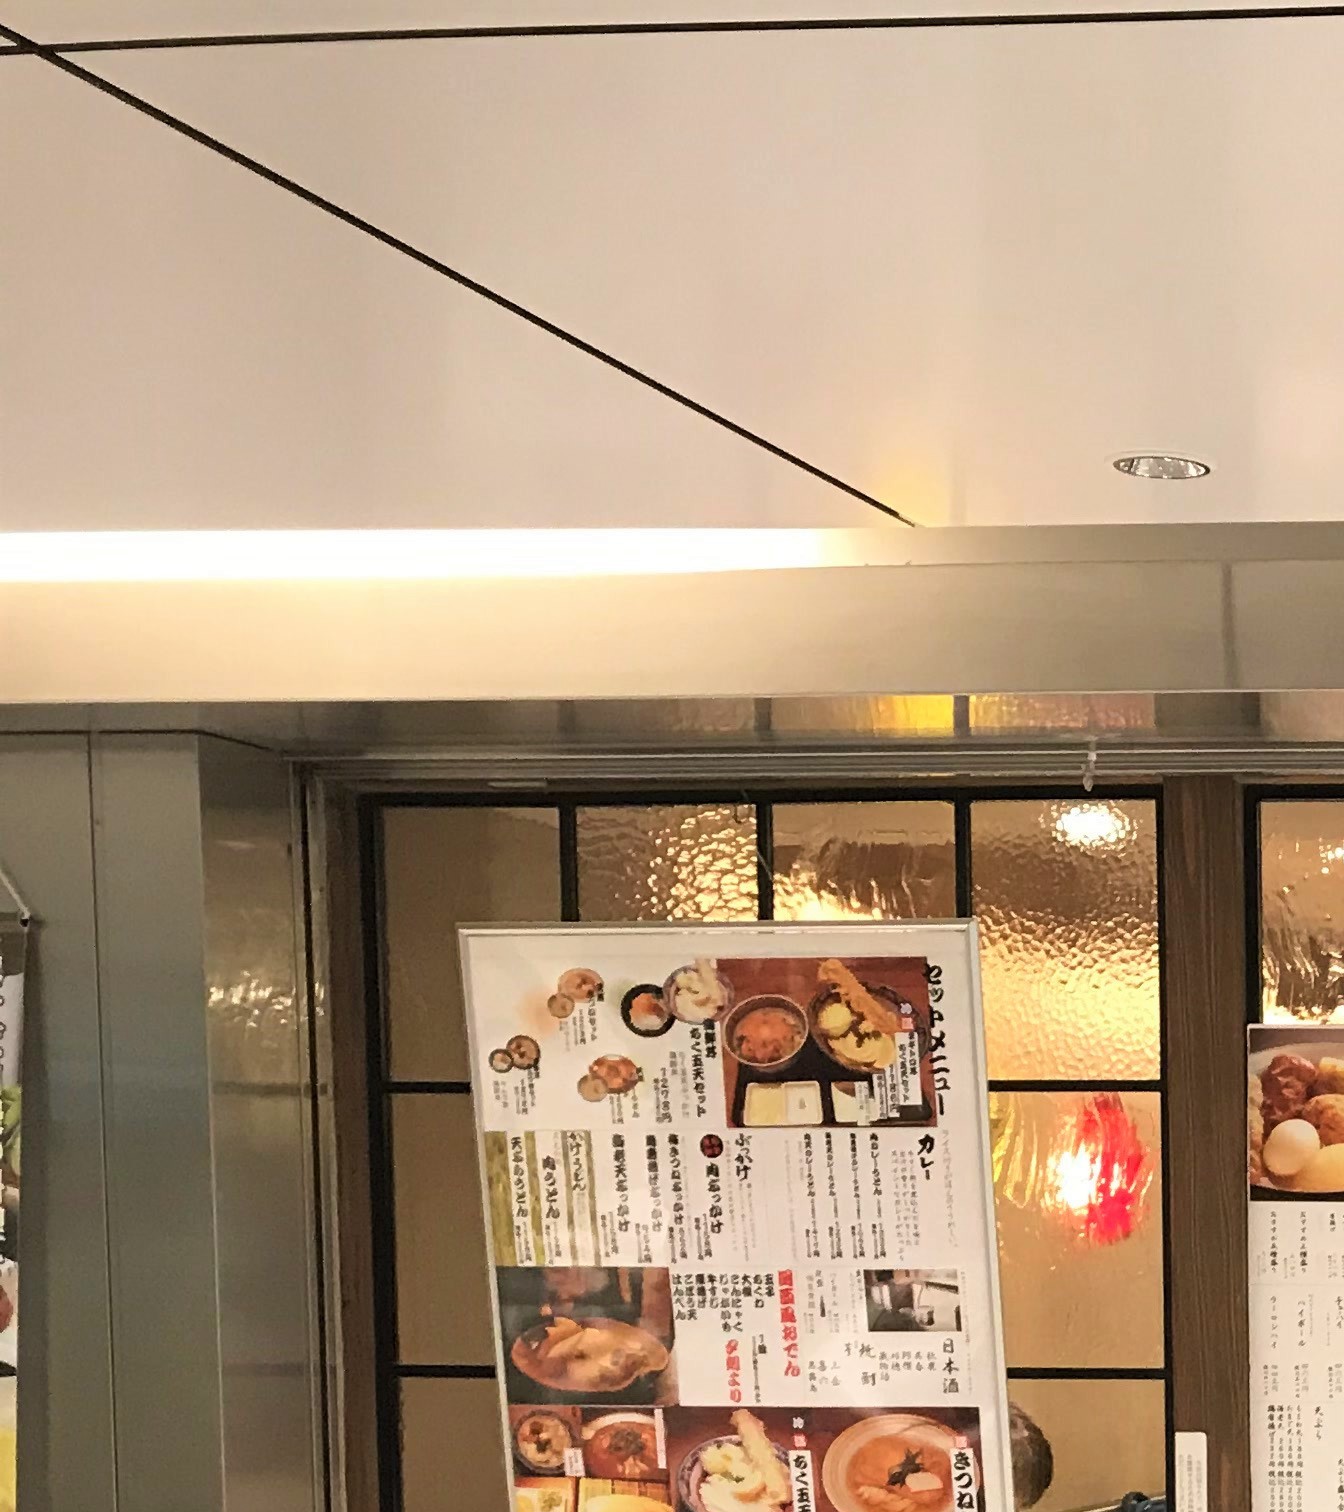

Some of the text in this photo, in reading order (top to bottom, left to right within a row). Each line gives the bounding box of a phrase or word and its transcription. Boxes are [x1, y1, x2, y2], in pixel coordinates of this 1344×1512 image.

[922, 963, 951, 1116] セットメニュー
[735, 1133, 753, 1181] ぶっかけ
[917, 1133, 935, 1180] カレー
[943, 1338, 959, 1393] 日本酒
